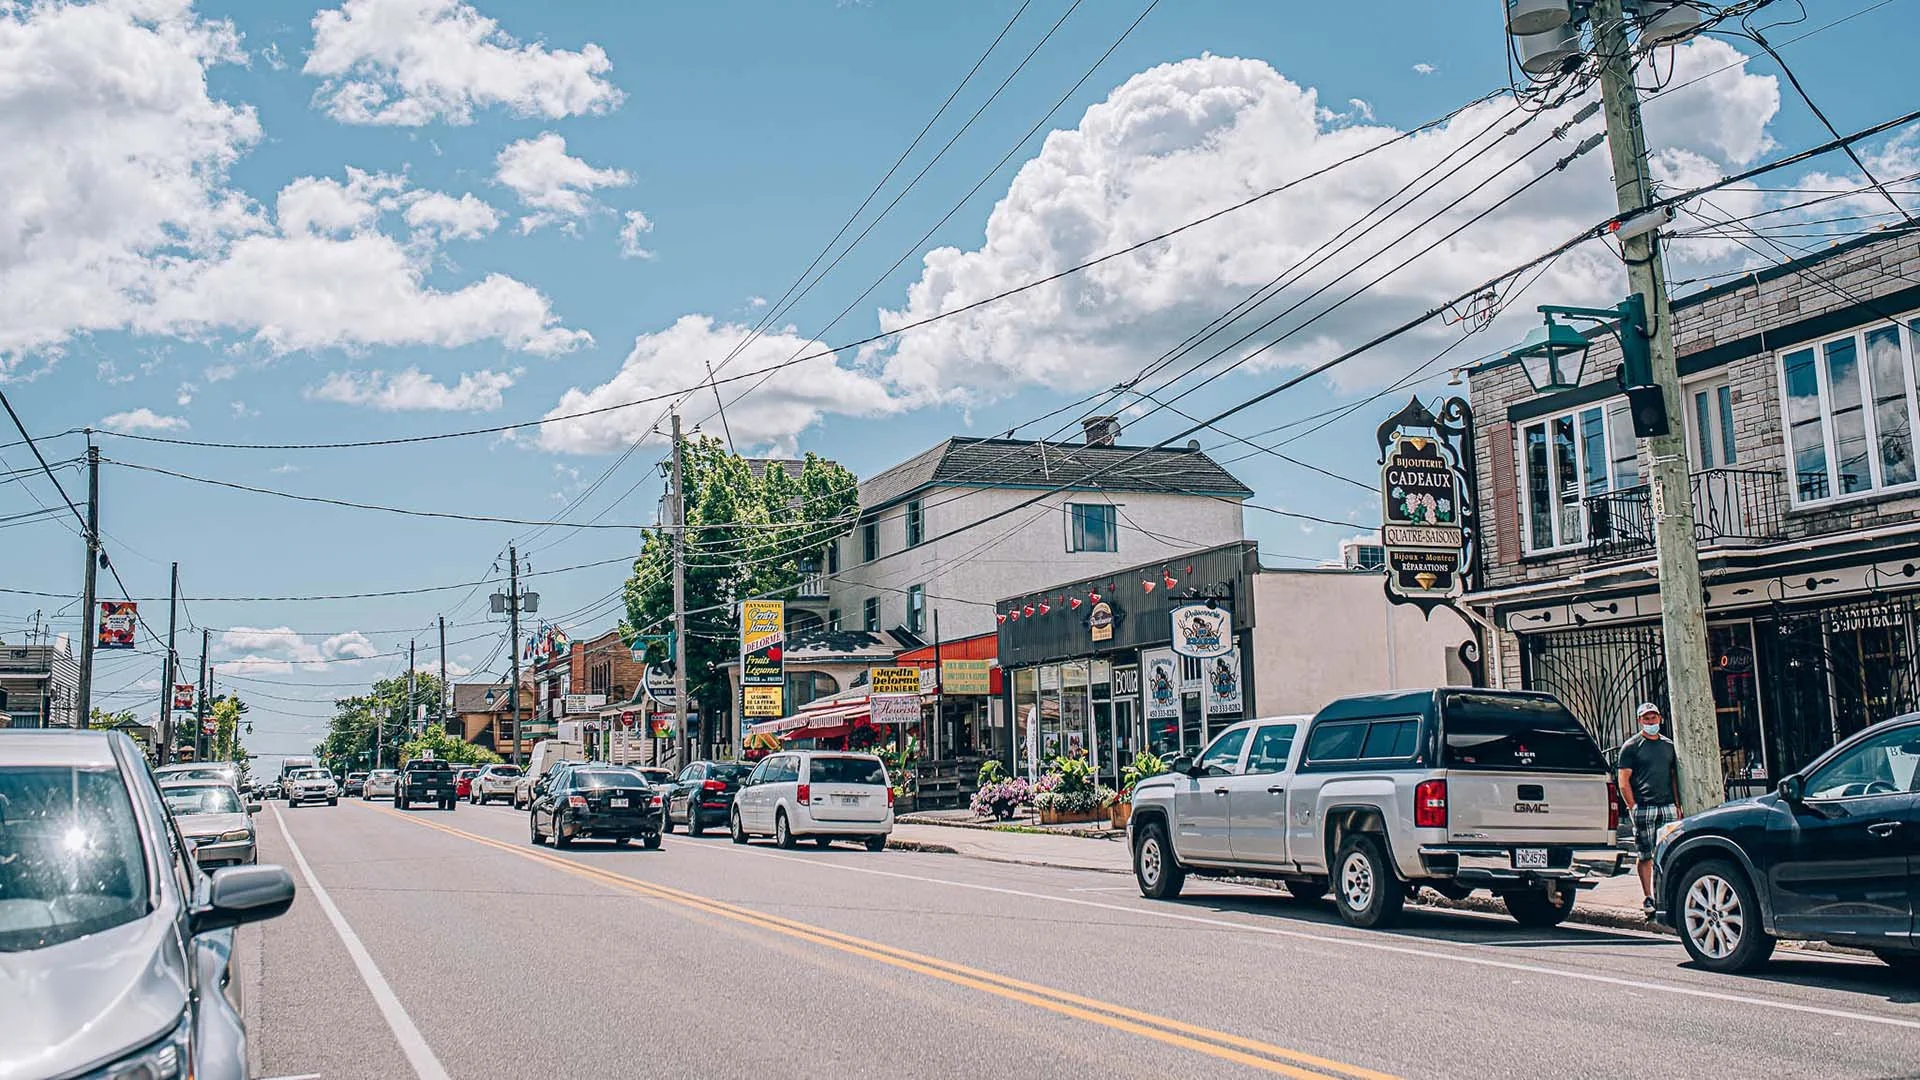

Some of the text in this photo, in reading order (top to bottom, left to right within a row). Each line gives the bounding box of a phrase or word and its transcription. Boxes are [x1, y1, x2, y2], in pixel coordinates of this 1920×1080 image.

[1396, 457, 1443, 469] BIJOUTERIE
[1389, 471, 1450, 488] CADEAUX
[1388, 528, 1460, 545] QUATRE-SAISONS
[1394, 552, 1418, 562] Bijoux
[1425, 554, 1455, 562] Montres
[1401, 562, 1449, 572] RÉPARATIONS
[748, 608, 778, 621] Centre
[745, 620, 778, 635] Jardin
[746, 632, 780, 653] DELORME
[746, 655, 770, 664] Fruits
[746, 665, 780, 676] Légumes
[877, 668, 913, 677] Jardin
[873, 676, 919, 685] Delorme
[1514, 803, 1549, 813] GMC
